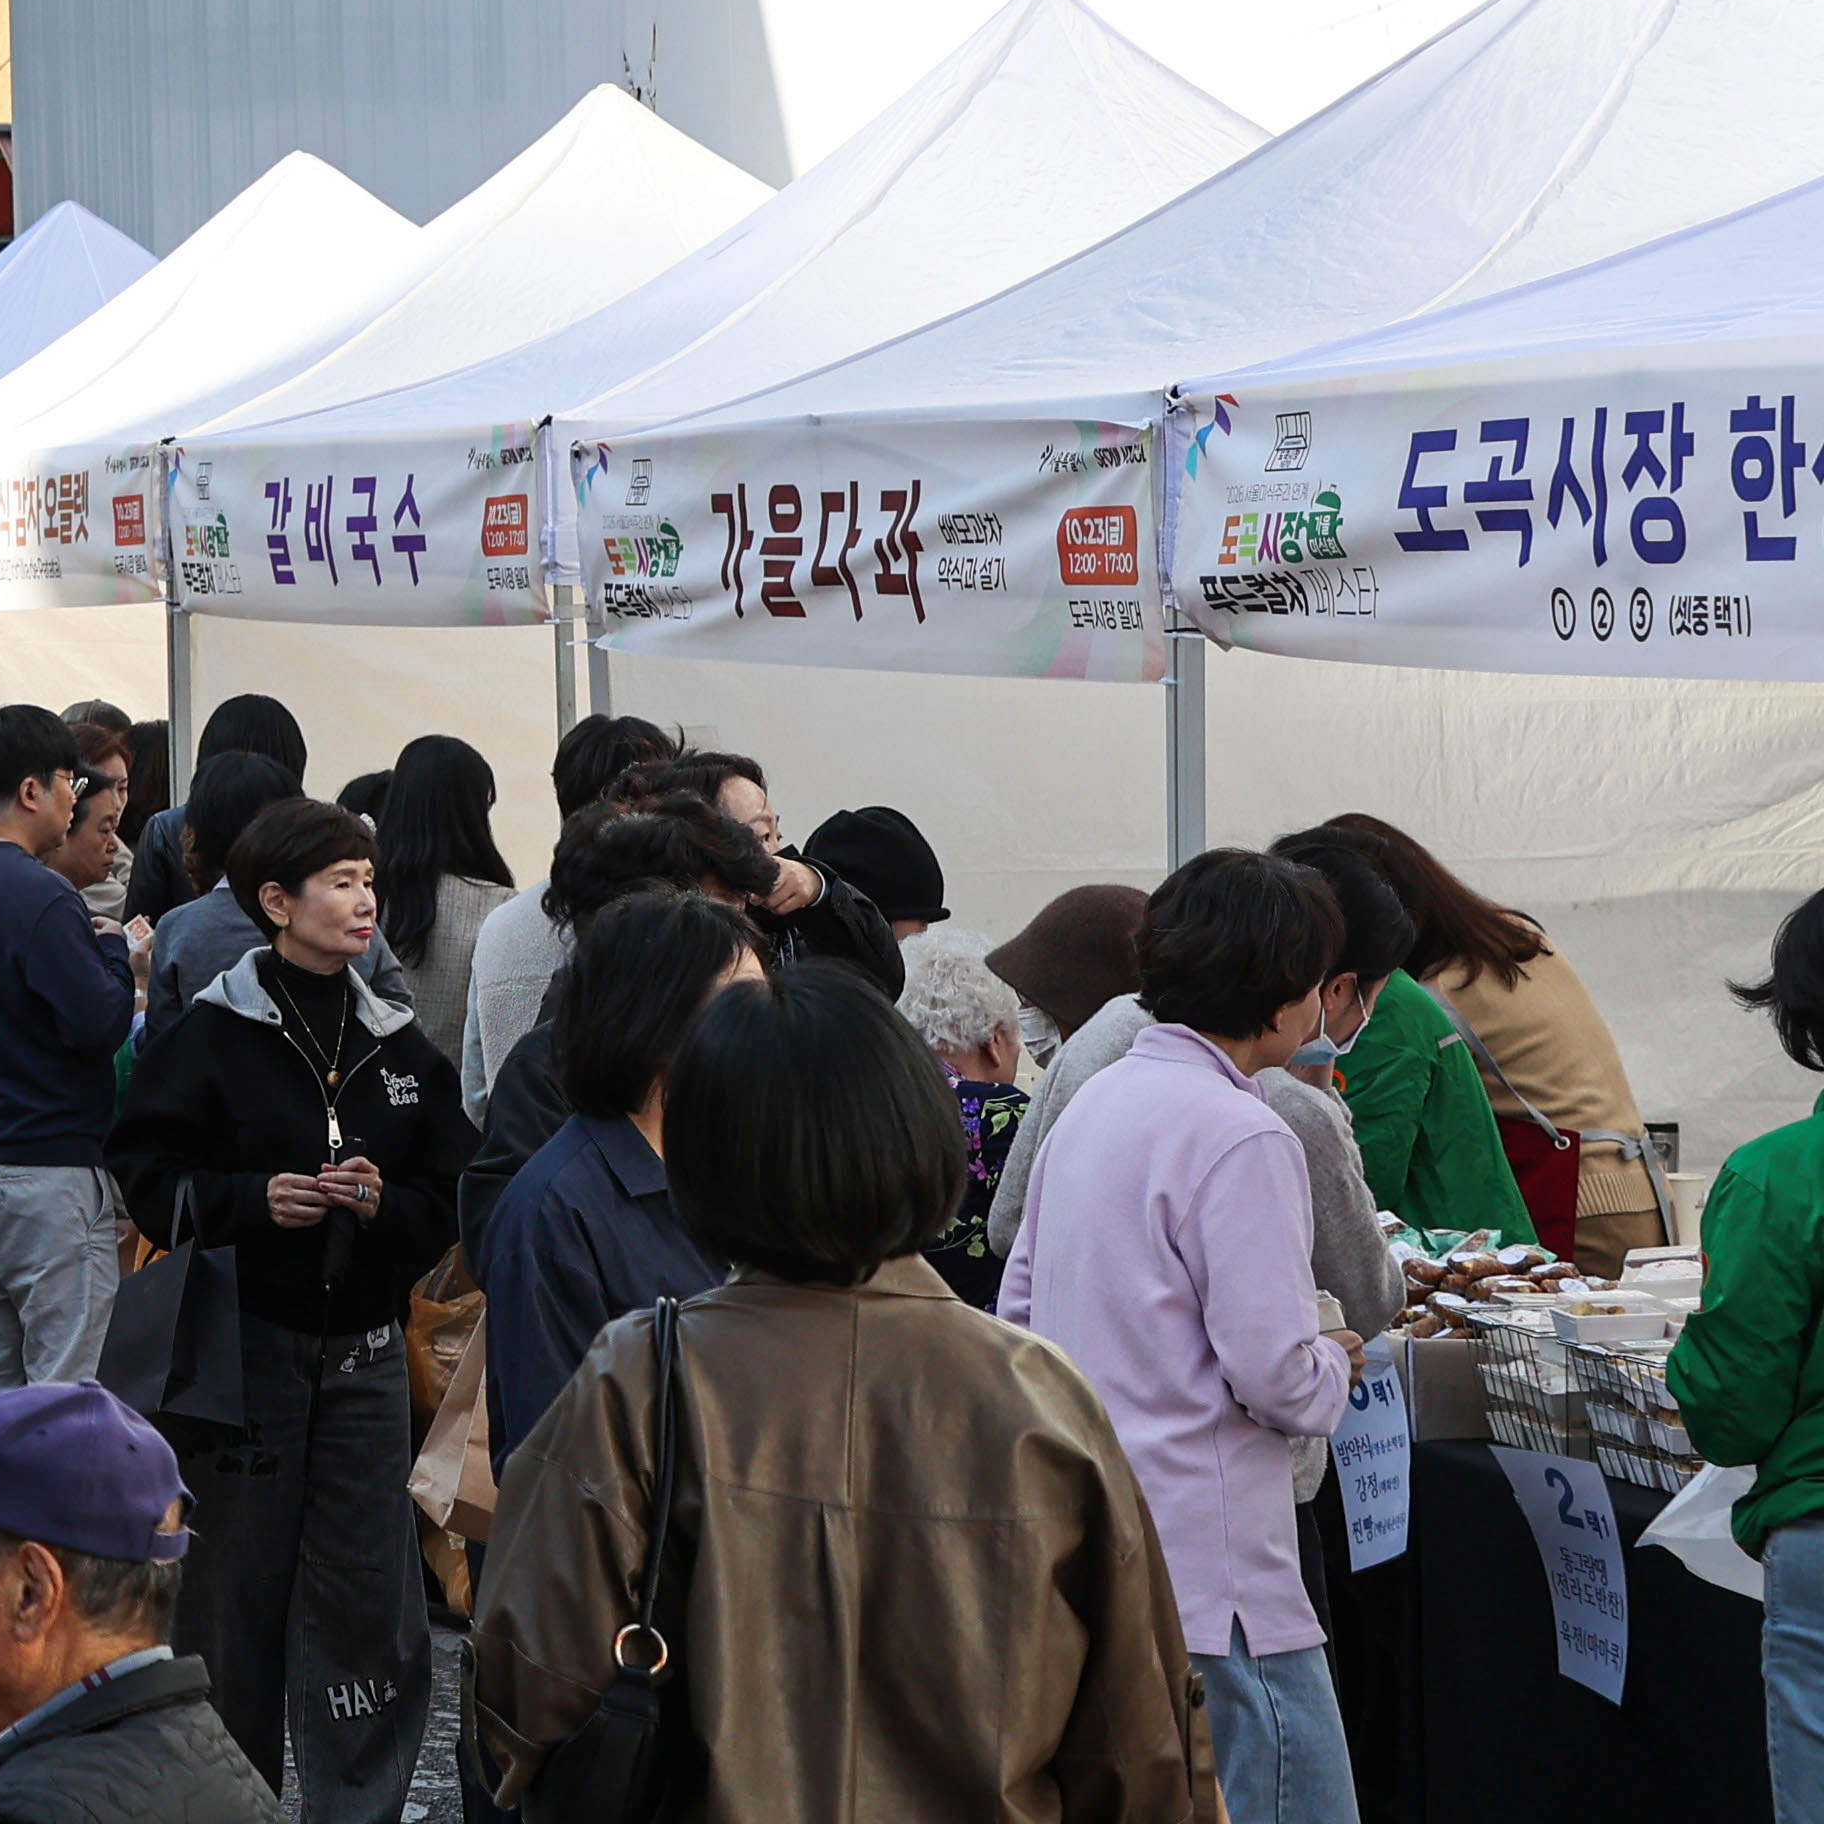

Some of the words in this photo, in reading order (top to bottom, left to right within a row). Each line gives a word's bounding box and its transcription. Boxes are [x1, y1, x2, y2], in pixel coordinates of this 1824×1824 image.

[1394, 401, 1695, 569] 도곡시장
[13, 475, 42, 545] 감자
[43, 471, 90, 547] 오믈렛
[486, 501, 524, 529] 10.23(금)
[1313, 514, 1333, 536] 가을
[263, 473, 428, 588] 갈비국수
[485, 531, 506, 548] 12:00
[937, 513, 1003, 549] 배모과차
[1064, 515, 1124, 547] 10.23(금)
[1217, 511, 1309, 565] 도곡시장
[1309, 536, 1339, 558] 미식회
[710, 479, 924, 623] 가을다과
[1068, 552, 1096, 574] 12:00
[1104, 552, 1134, 574] 17:00
[937, 554, 977, 592] 약식과
[978, 559, 1008, 592] 설기
[1199, 571, 1310, 617] 푸드컬처
[1310, 565, 1380, 620] 페스타
[1068, 599, 1116, 630] 도곡시장
[1117, 601, 1144, 630] 일대
[1354, 1471, 1378, 1503] 강정
[1558, 1546, 1608, 1587] 동그랑땡
[1550, 1571, 1624, 1623] (전라도반찬)
[327, 1678, 382, 1722] HA!
